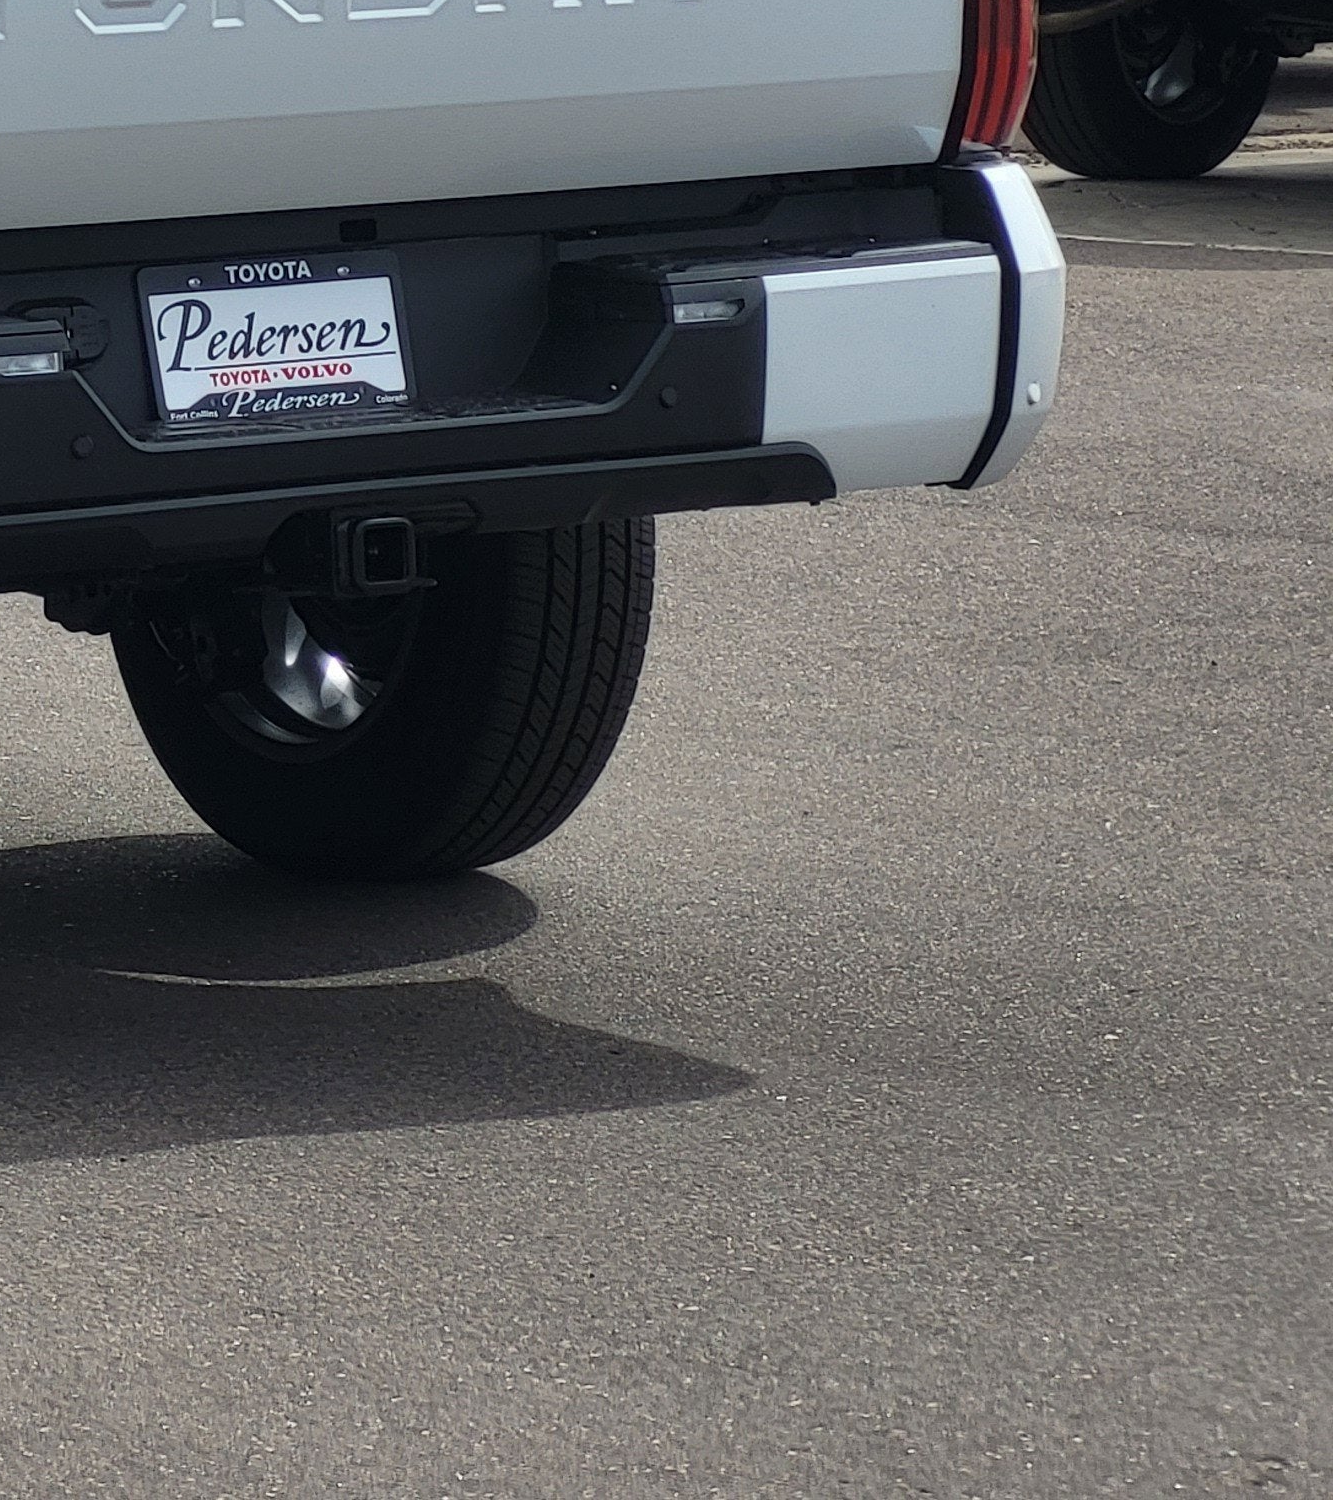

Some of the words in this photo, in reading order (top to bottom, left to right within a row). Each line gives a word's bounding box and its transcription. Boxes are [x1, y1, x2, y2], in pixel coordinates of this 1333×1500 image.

[224, 260, 312, 284] TOYOTA
[157, 298, 391, 372] Pedersen
[209, 369, 271, 387] TOYOTA
[279, 363, 353, 381] VOLVO
[169, 411, 189, 421] Fort
[190, 409, 219, 420] Collins
[221, 388, 361, 418] Pedersen
[375, 393, 409, 405] Colorado
